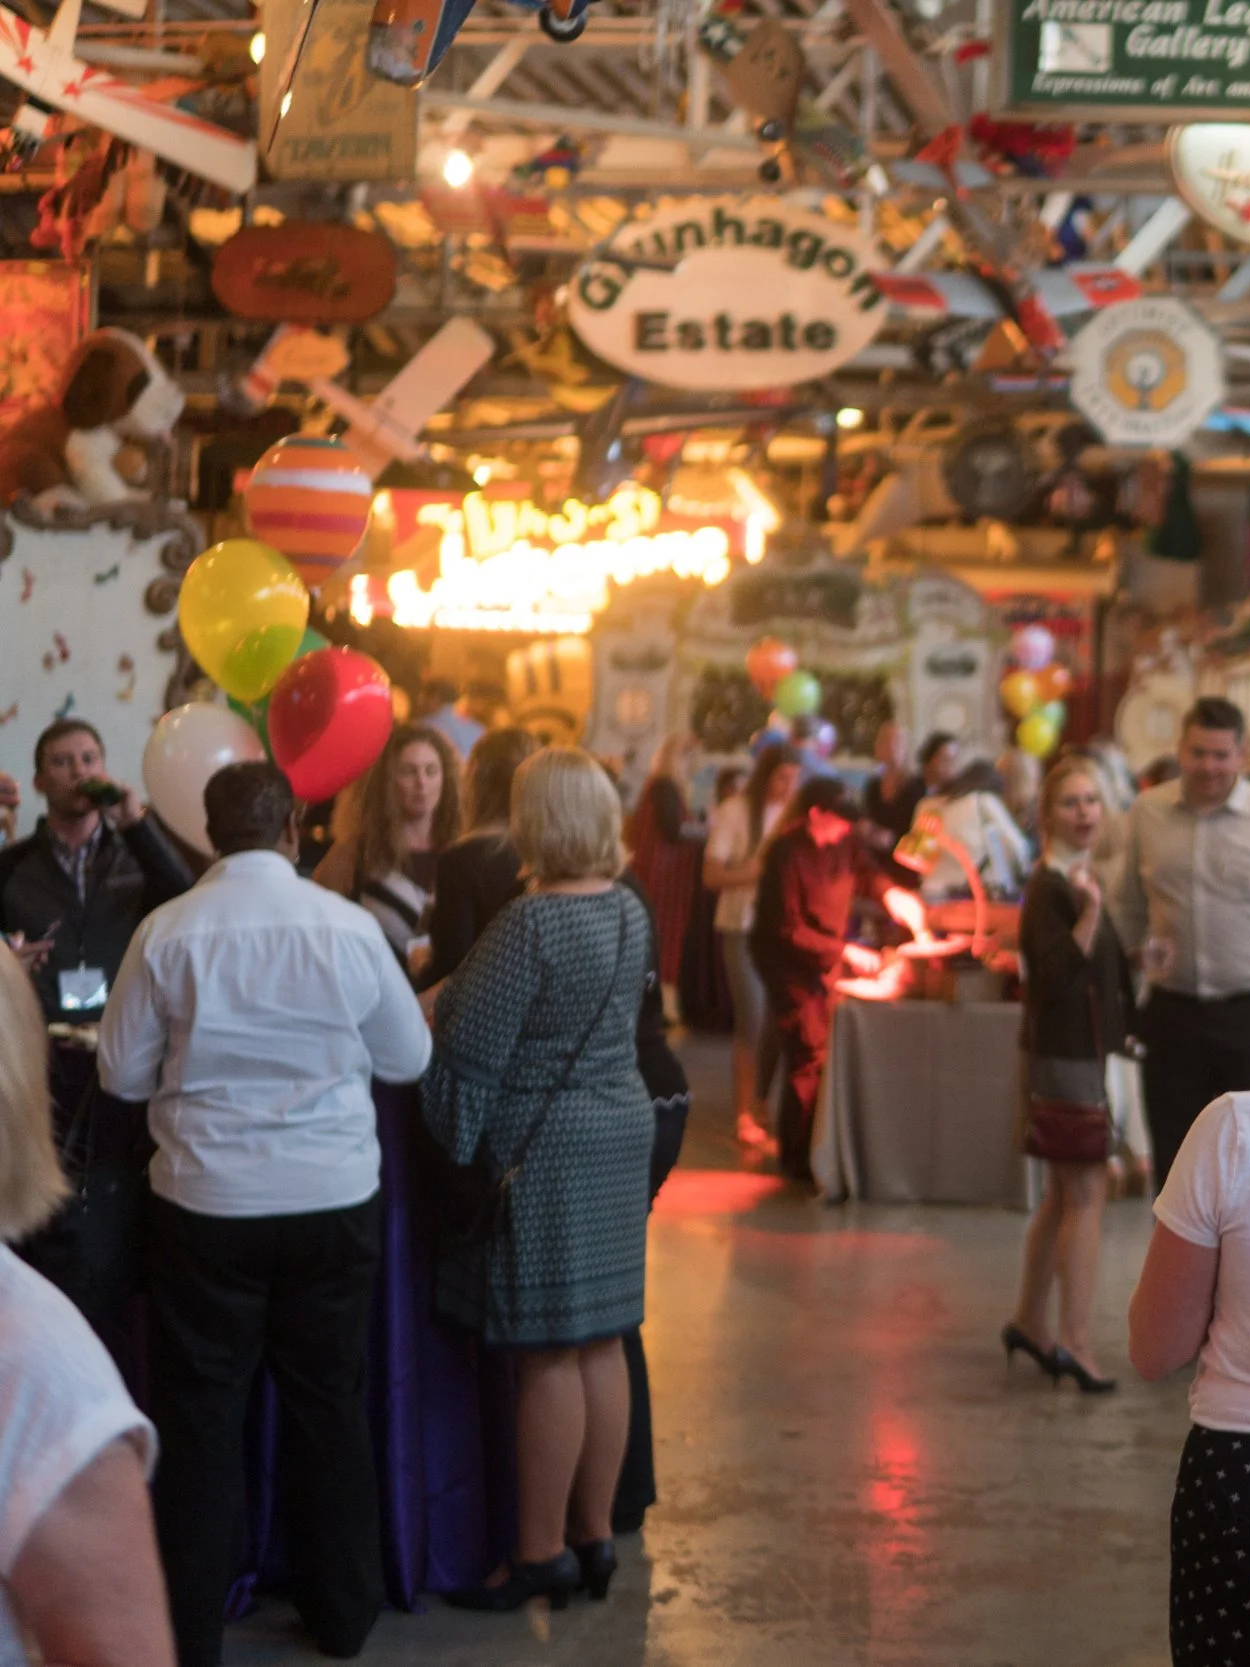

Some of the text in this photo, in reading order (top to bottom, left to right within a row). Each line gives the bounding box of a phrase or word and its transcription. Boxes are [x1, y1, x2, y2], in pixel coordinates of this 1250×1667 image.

[1022, 0, 1190, 23] American
[1032, 73, 1146, 95] Expressions
[1151, 73, 1180, 99] of
[1182, 74, 1222, 97] Art
[634, 312, 837, 351] Estate
